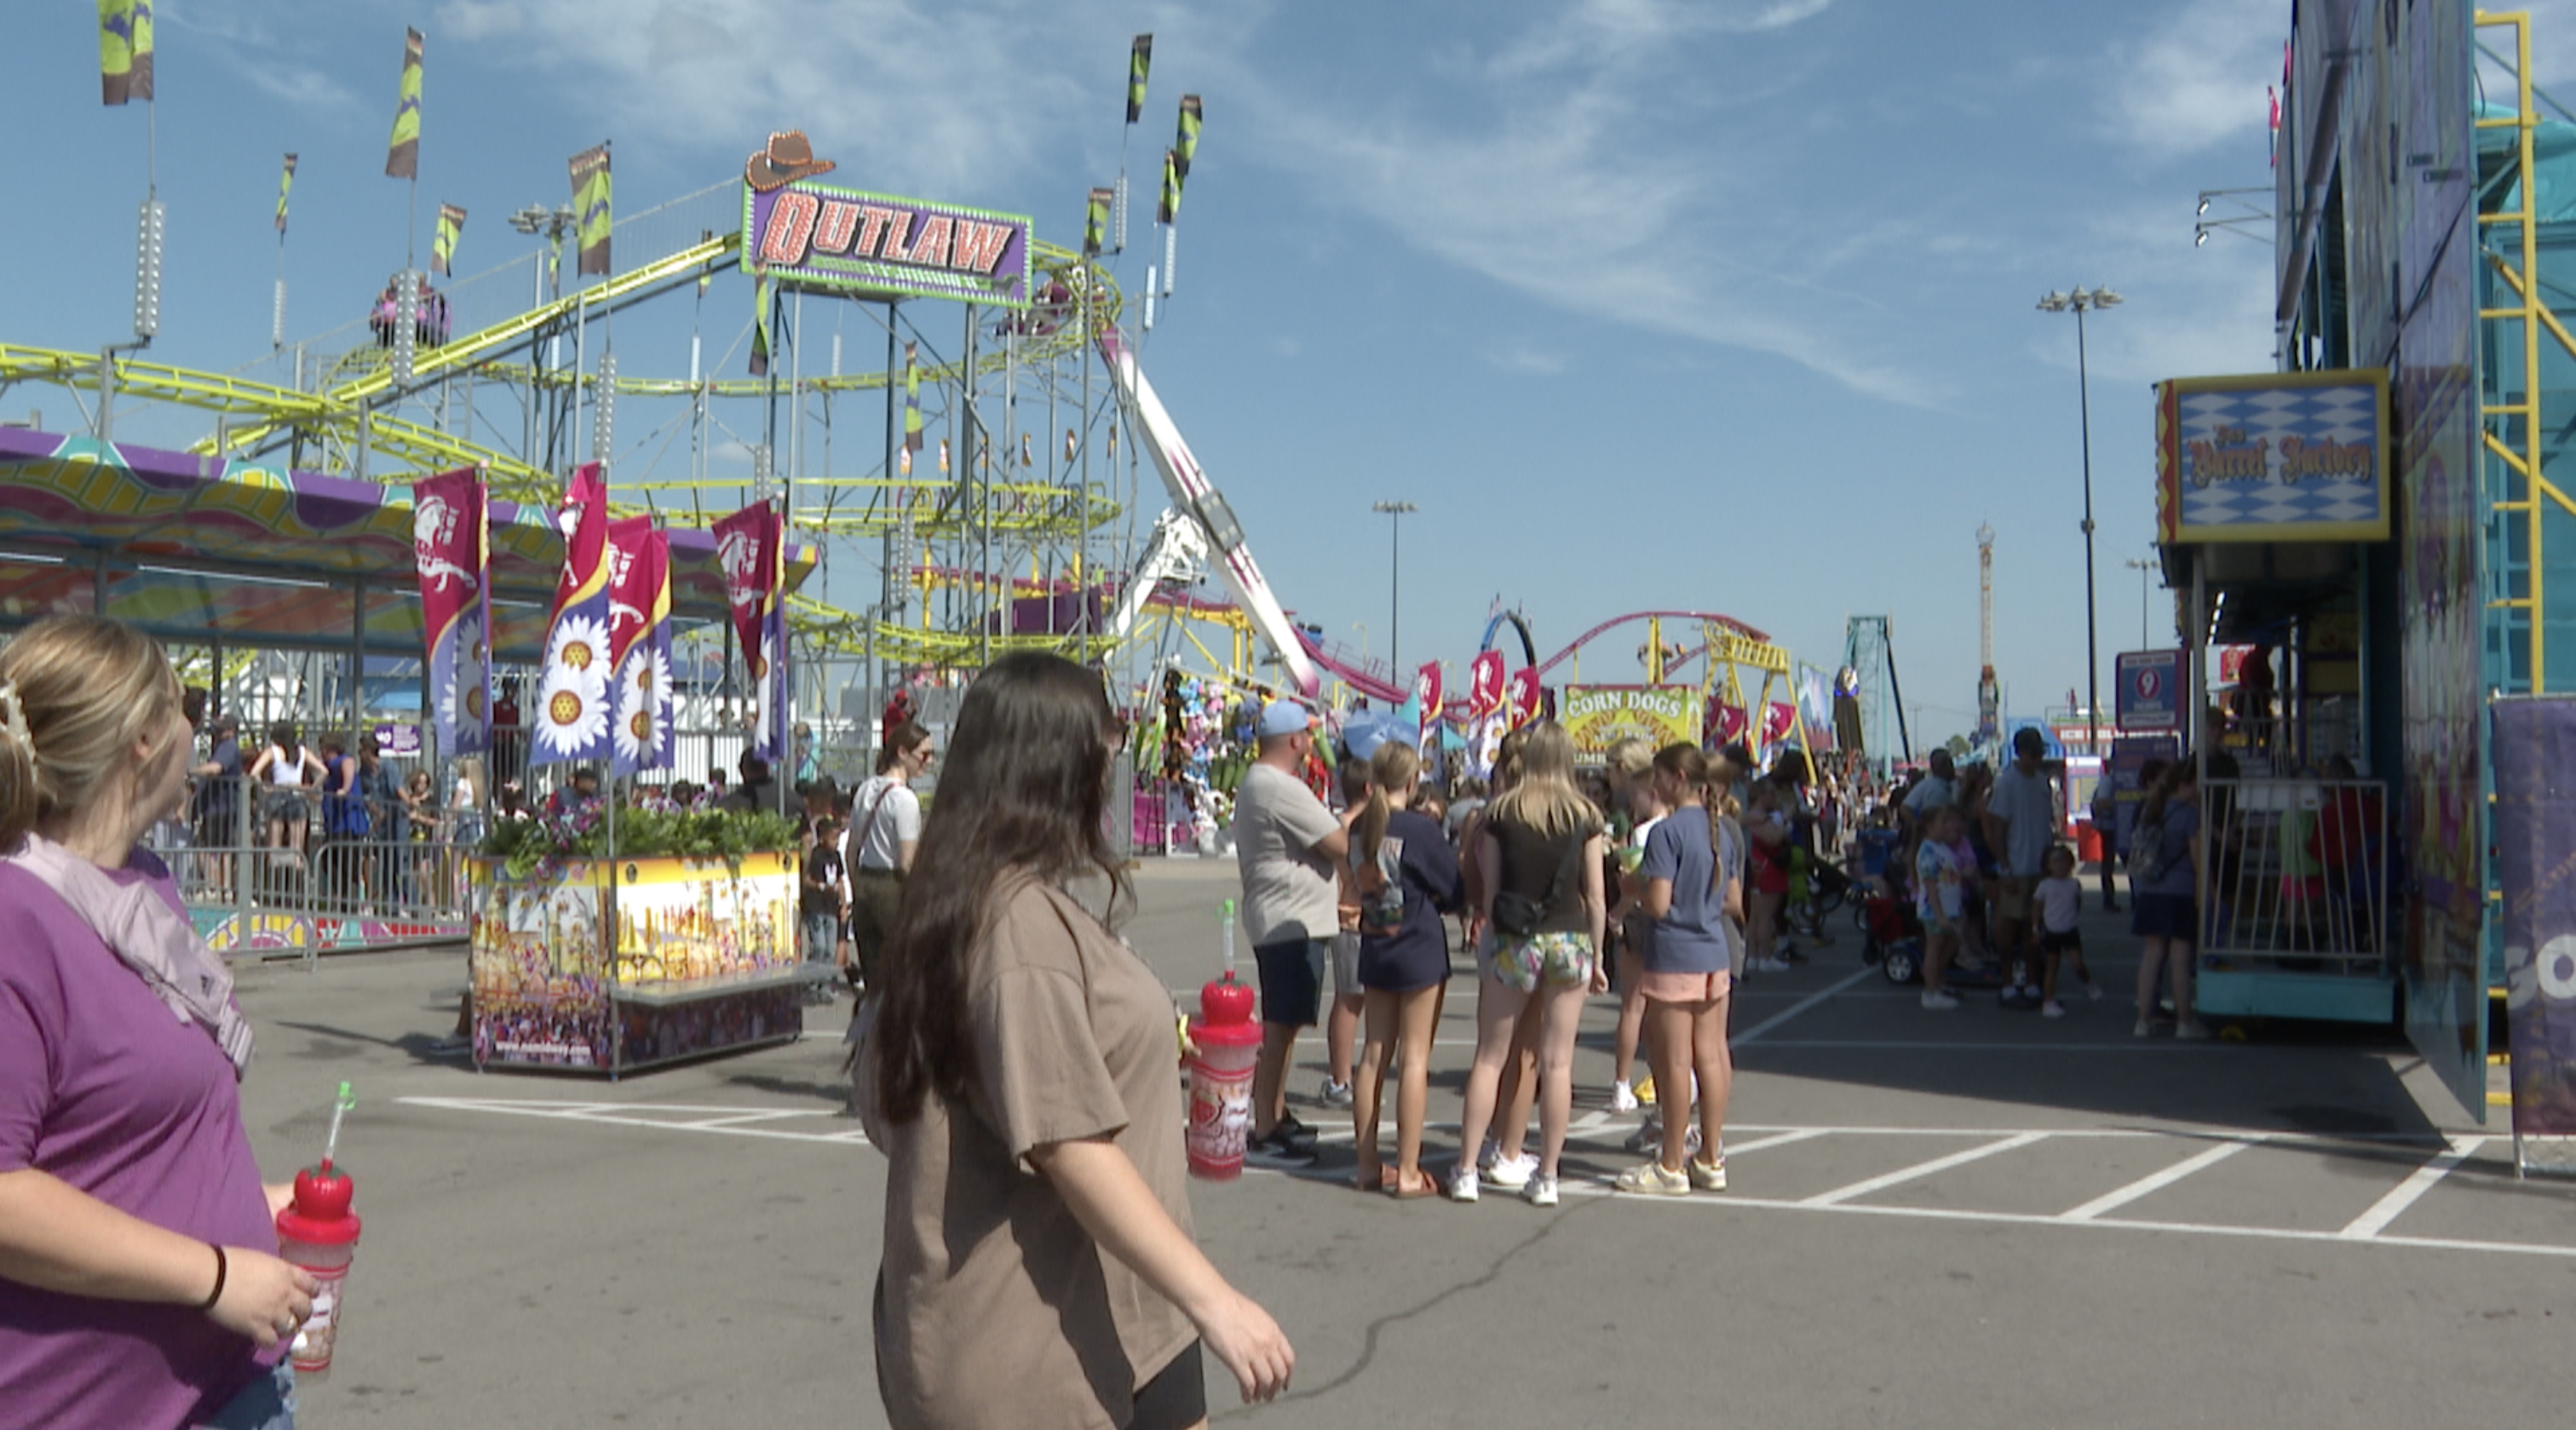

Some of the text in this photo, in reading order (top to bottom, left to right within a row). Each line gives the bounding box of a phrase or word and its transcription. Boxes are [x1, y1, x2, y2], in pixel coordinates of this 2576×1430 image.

[759, 192, 1015, 275] OUTLAW
[2188, 434, 2373, 488] Barrel Factory
[2142, 670, 2155, 696] 9
[1567, 691, 1682, 718] CORN DOGS
